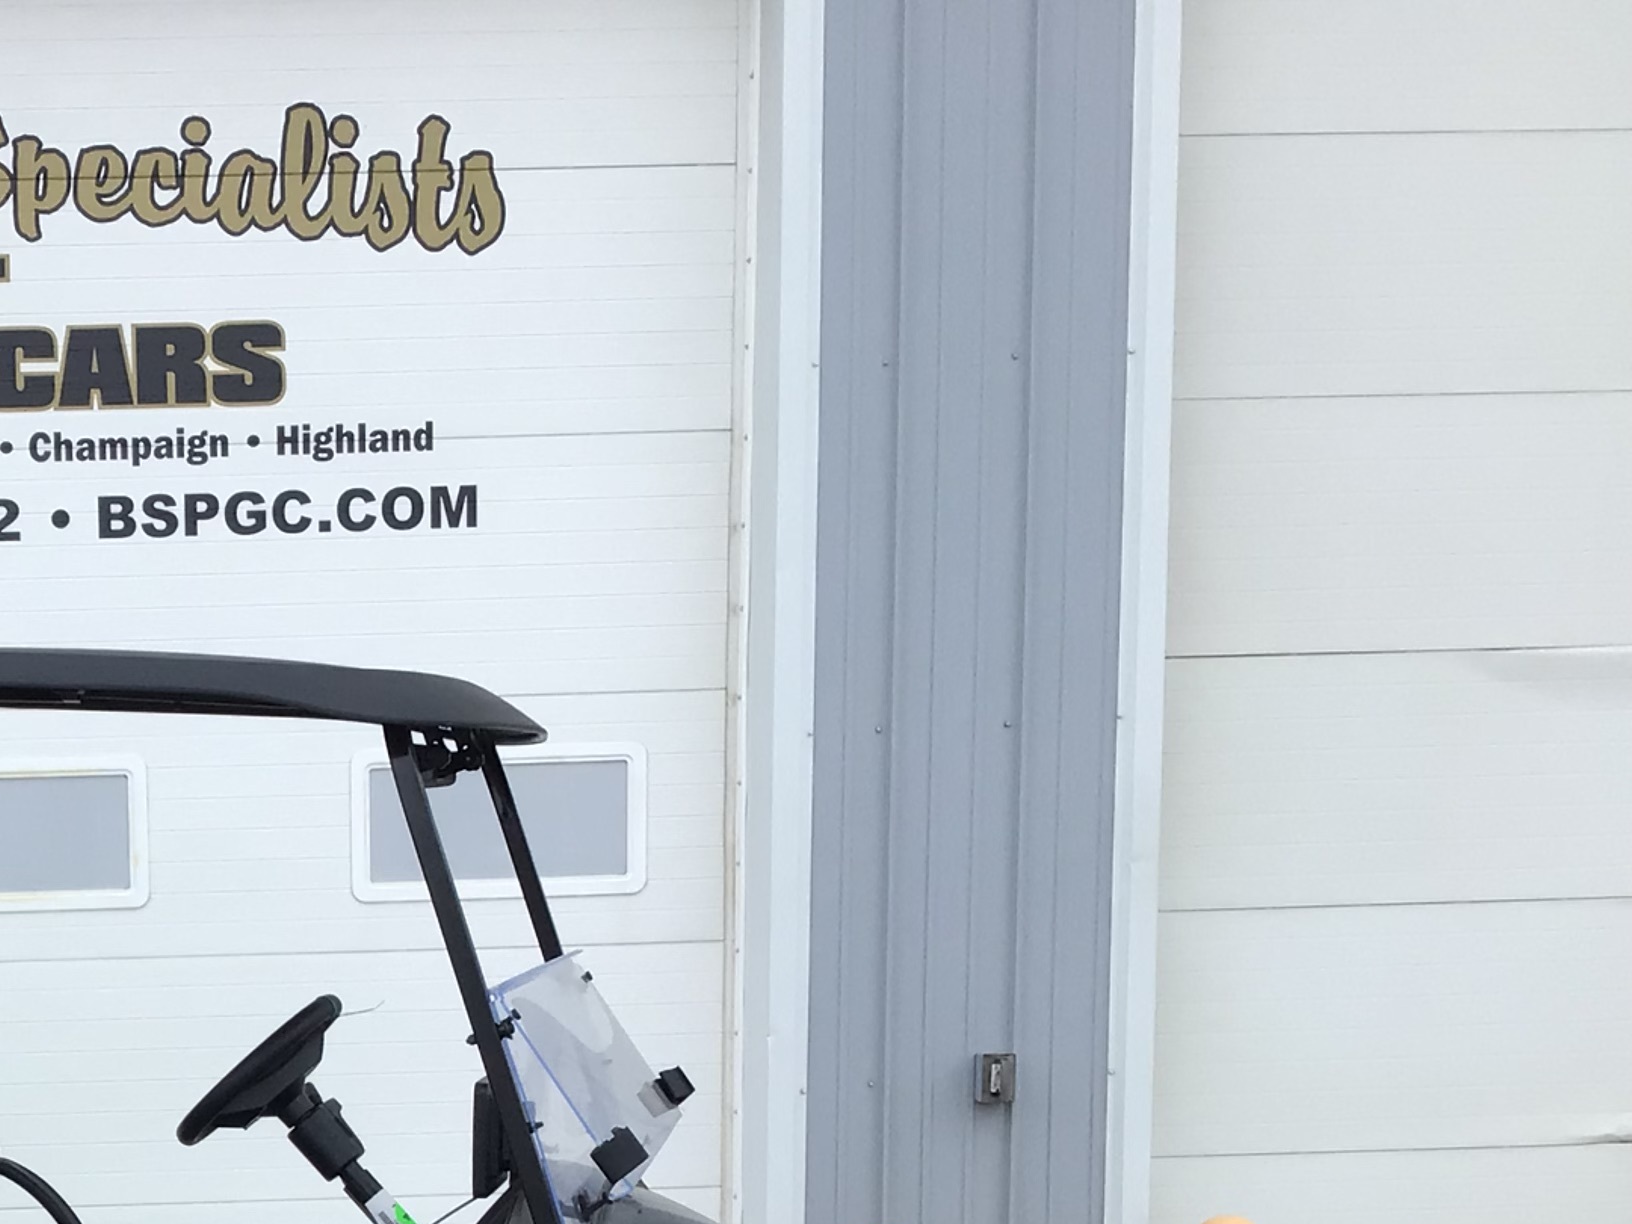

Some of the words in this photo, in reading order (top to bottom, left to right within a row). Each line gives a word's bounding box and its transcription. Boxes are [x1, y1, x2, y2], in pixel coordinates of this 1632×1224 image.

[28, 429, 231, 466] Champaign
[275, 421, 435, 461] Highland
[96, 484, 480, 540] BSPGC.COM
